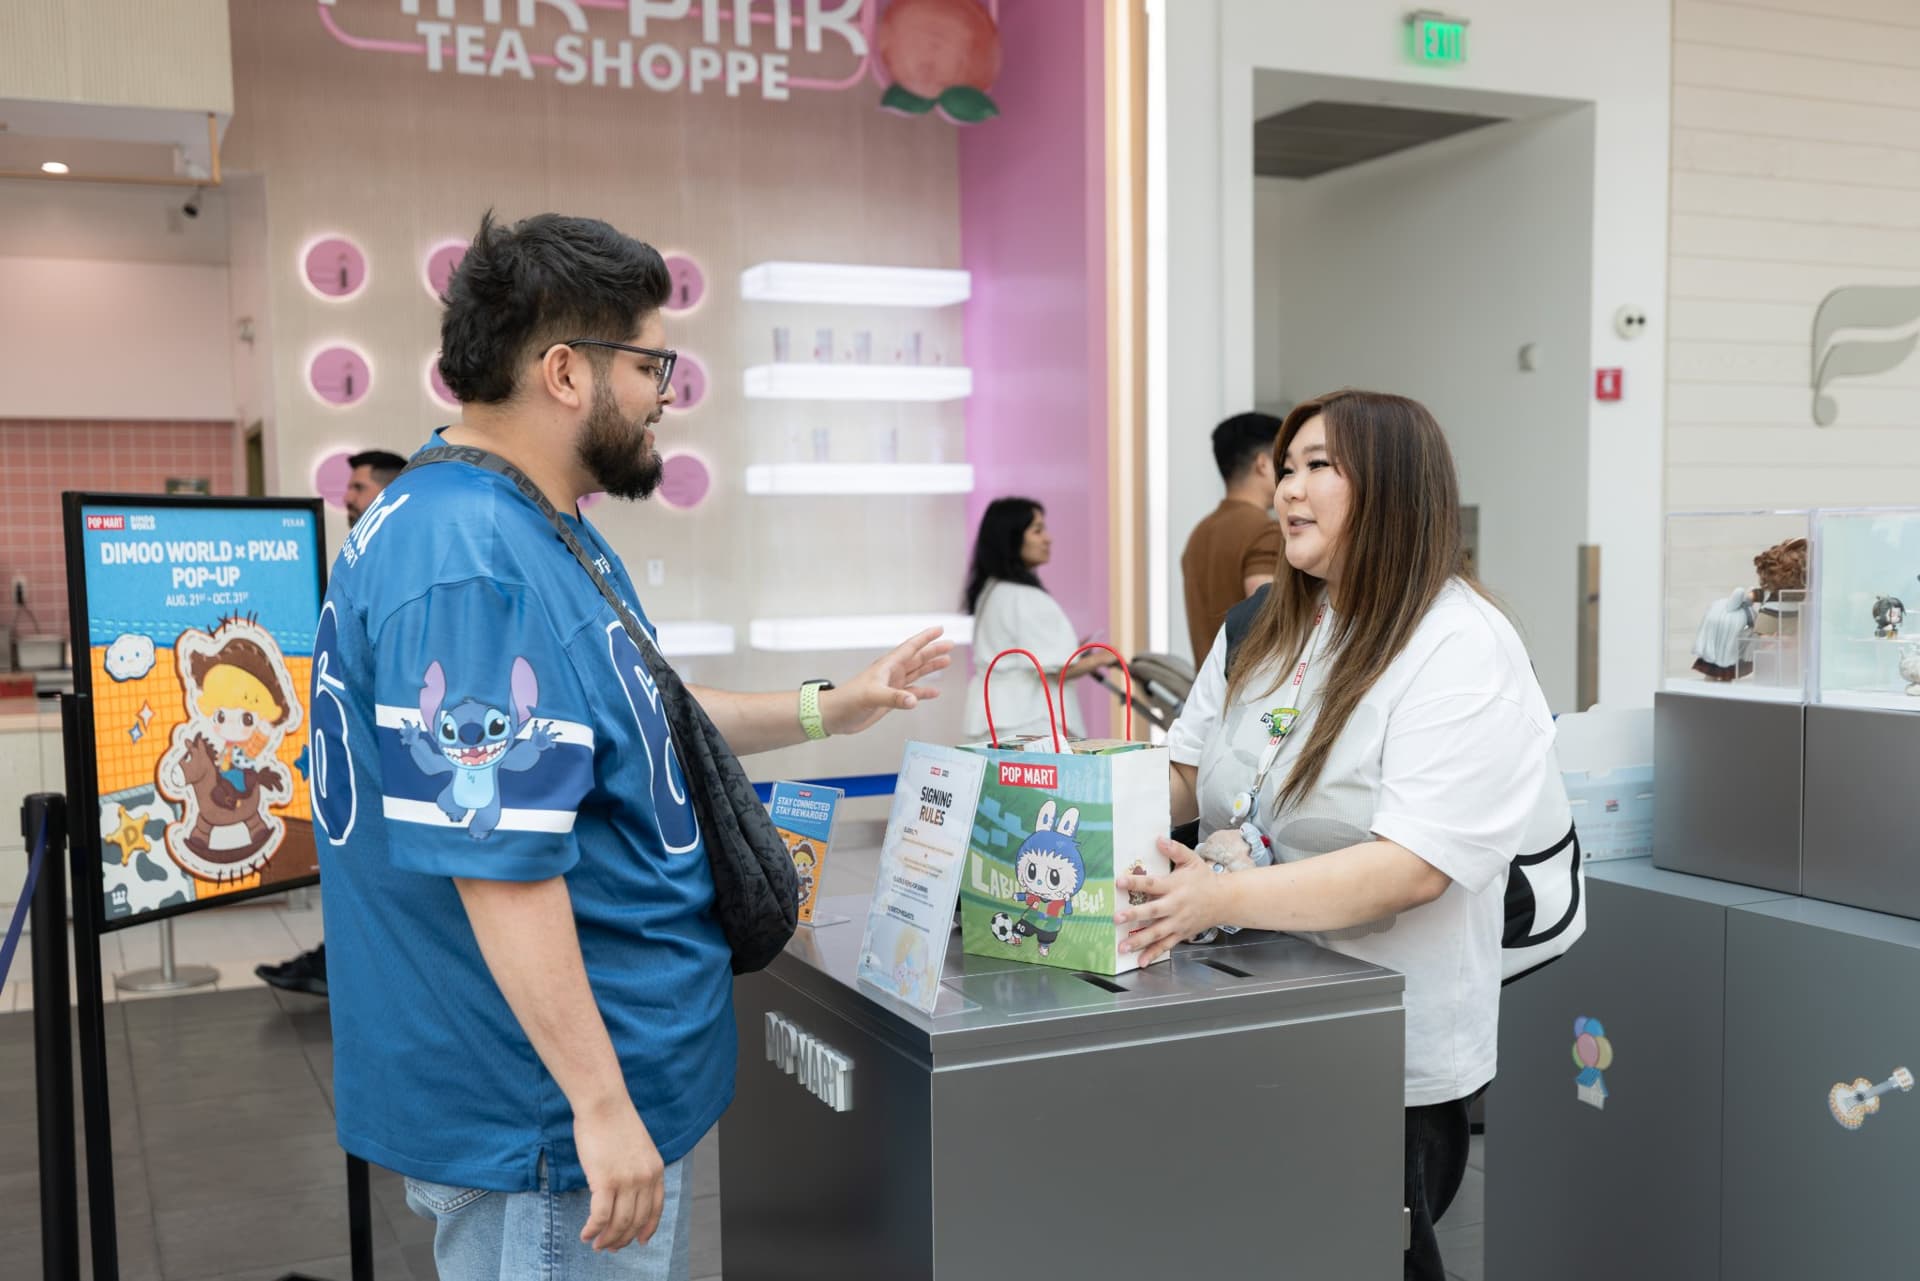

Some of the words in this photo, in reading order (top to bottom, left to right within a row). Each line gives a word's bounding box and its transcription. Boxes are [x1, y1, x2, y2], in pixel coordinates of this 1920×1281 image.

[1425, 23, 1463, 60] EXIT
[416, 21, 534, 80] TEA
[554, 34, 789, 100] SHOPPE
[87, 516, 102, 529] POP
[103, 516, 123, 529] MART
[101, 542, 164, 564] DIMOO
[165, 541, 232, 563] WORLD
[248, 540, 299, 561] PIXAR
[172, 566, 240, 589] POP-UP
[166, 593, 188, 607] AUG.
[212, 592, 231, 605] OCT.
[1001, 765, 1022, 784] POP
[1024, 767, 1055, 786] MART
[777, 796, 793, 806] STAY
[792, 798, 830, 812] CONNECTED
[920, 786, 952, 808] SIGNING
[775, 805, 791, 815] STAY
[790, 807, 829, 821] REWARDED
[919, 805, 945, 826] RULES
[123, 828, 139, 847] D
[765, 1010, 799, 1074] POP
[798, 1032, 855, 1112] MART
